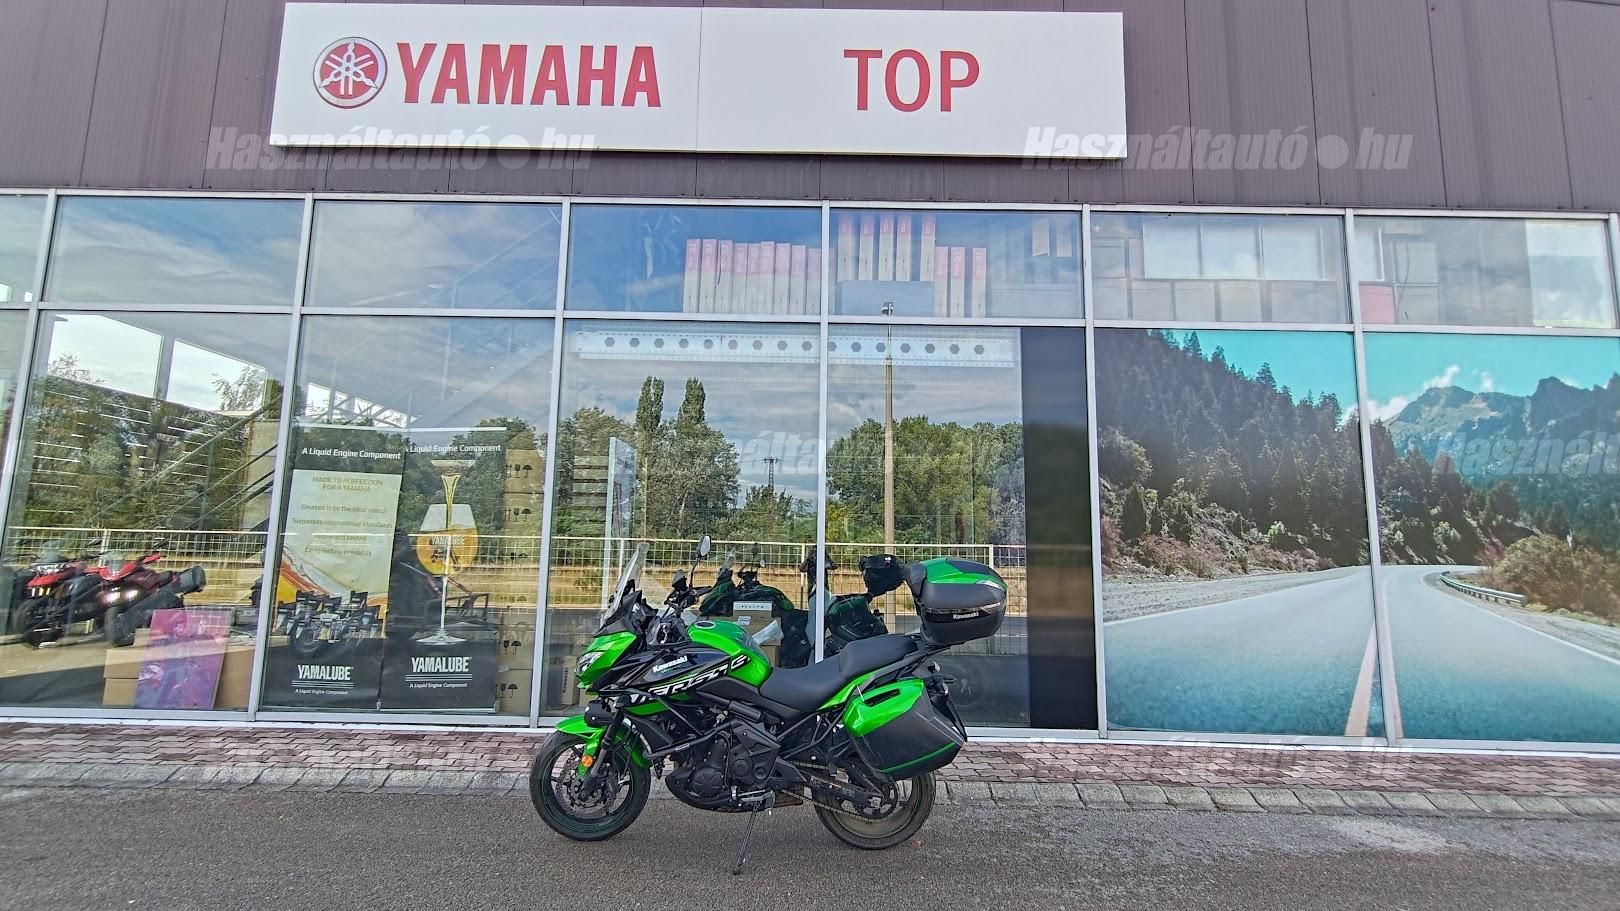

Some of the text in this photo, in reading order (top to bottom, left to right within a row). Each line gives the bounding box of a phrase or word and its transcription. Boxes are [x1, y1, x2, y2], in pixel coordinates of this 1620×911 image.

[396, 42, 662, 108] YAMAHA
[843, 48, 980, 113] TOP
[302, 447, 401, 460] A Liquid Engine Component
[410, 445, 432, 454] Liquid
[433, 444, 458, 454] Engine
[459, 444, 502, 454] Component
[343, 477, 384, 486] PERFECTION
[343, 484, 371, 492] YAMAHA
[953, 611, 979, 620] Kawasaki
[411, 656, 470, 673] YAMALUBE
[652, 655, 688, 673] Kawasaki
[297, 664, 351, 681] YAMALUBE
